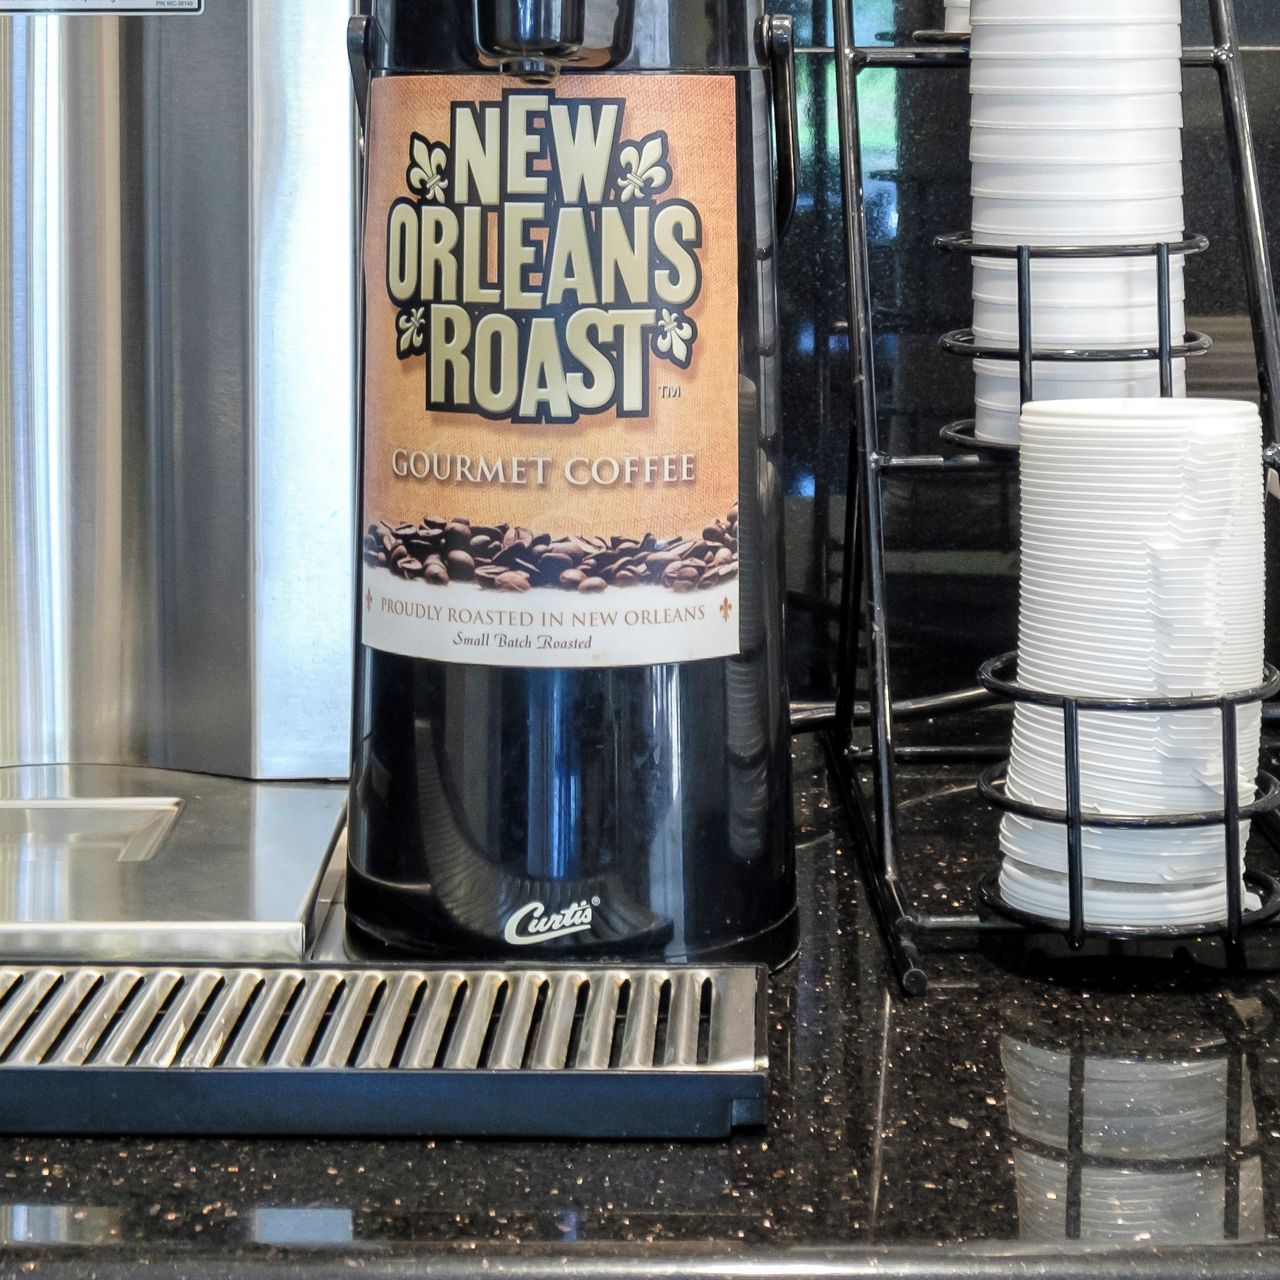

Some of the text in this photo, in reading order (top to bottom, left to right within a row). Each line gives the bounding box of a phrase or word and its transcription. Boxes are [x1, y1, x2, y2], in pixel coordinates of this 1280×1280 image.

[453, 94, 619, 205] NEW
[388, 201, 697, 310] ORLEANS
[430, 303, 657, 418] ROAST
[392, 448, 695, 485] GOURMET COFFEE
[381, 597, 705, 628] PROUDLY ROASTED IN NEW ORLEANS
[452, 631, 592, 649] Small Batch Roasted
[504, 899, 592, 945] Curtis
